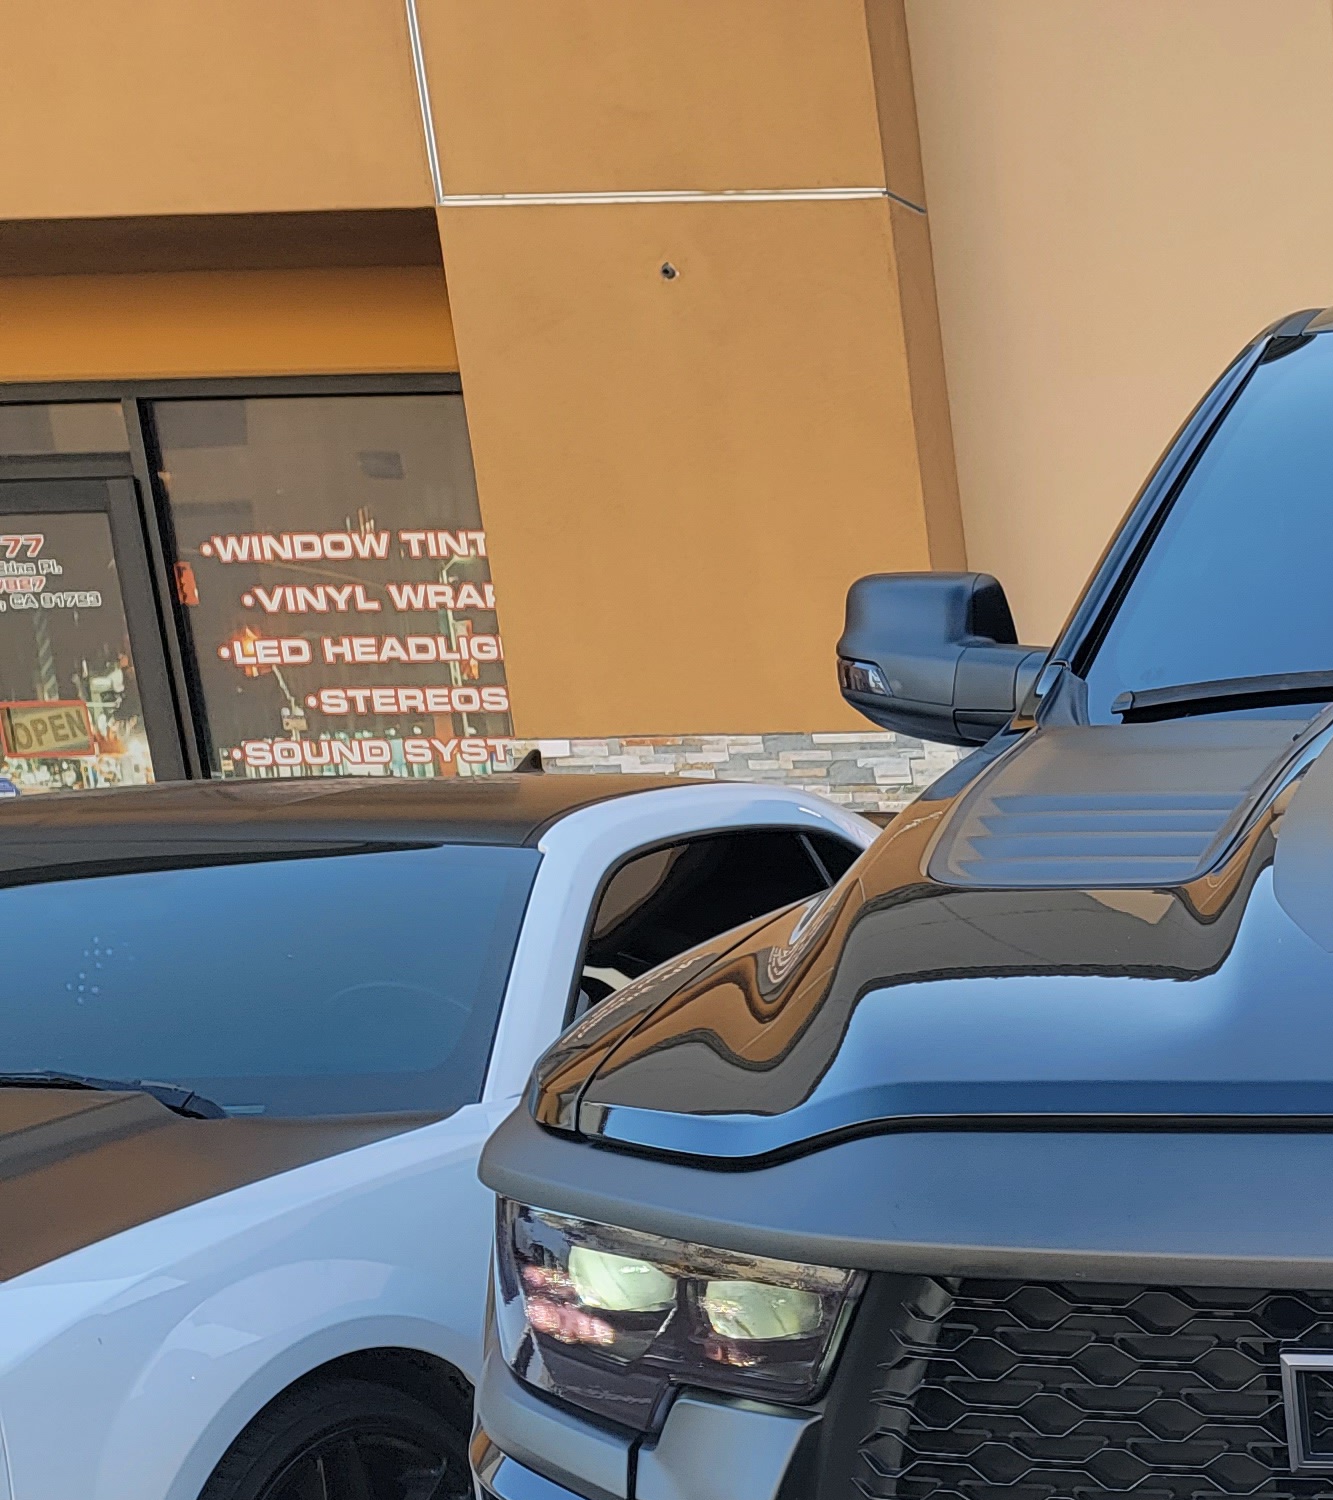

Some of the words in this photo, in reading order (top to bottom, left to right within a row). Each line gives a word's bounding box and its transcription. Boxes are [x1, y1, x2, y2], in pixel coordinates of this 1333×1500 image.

[210, 530, 390, 563] WINDOW
[252, 583, 381, 613] VINYL
[232, 637, 311, 664] LED
[321, 634, 504, 663] HEADLIG
[318, 686, 509, 714] STEREOS
[15, 710, 88, 750] OPEN
[244, 740, 391, 765] SOUND
